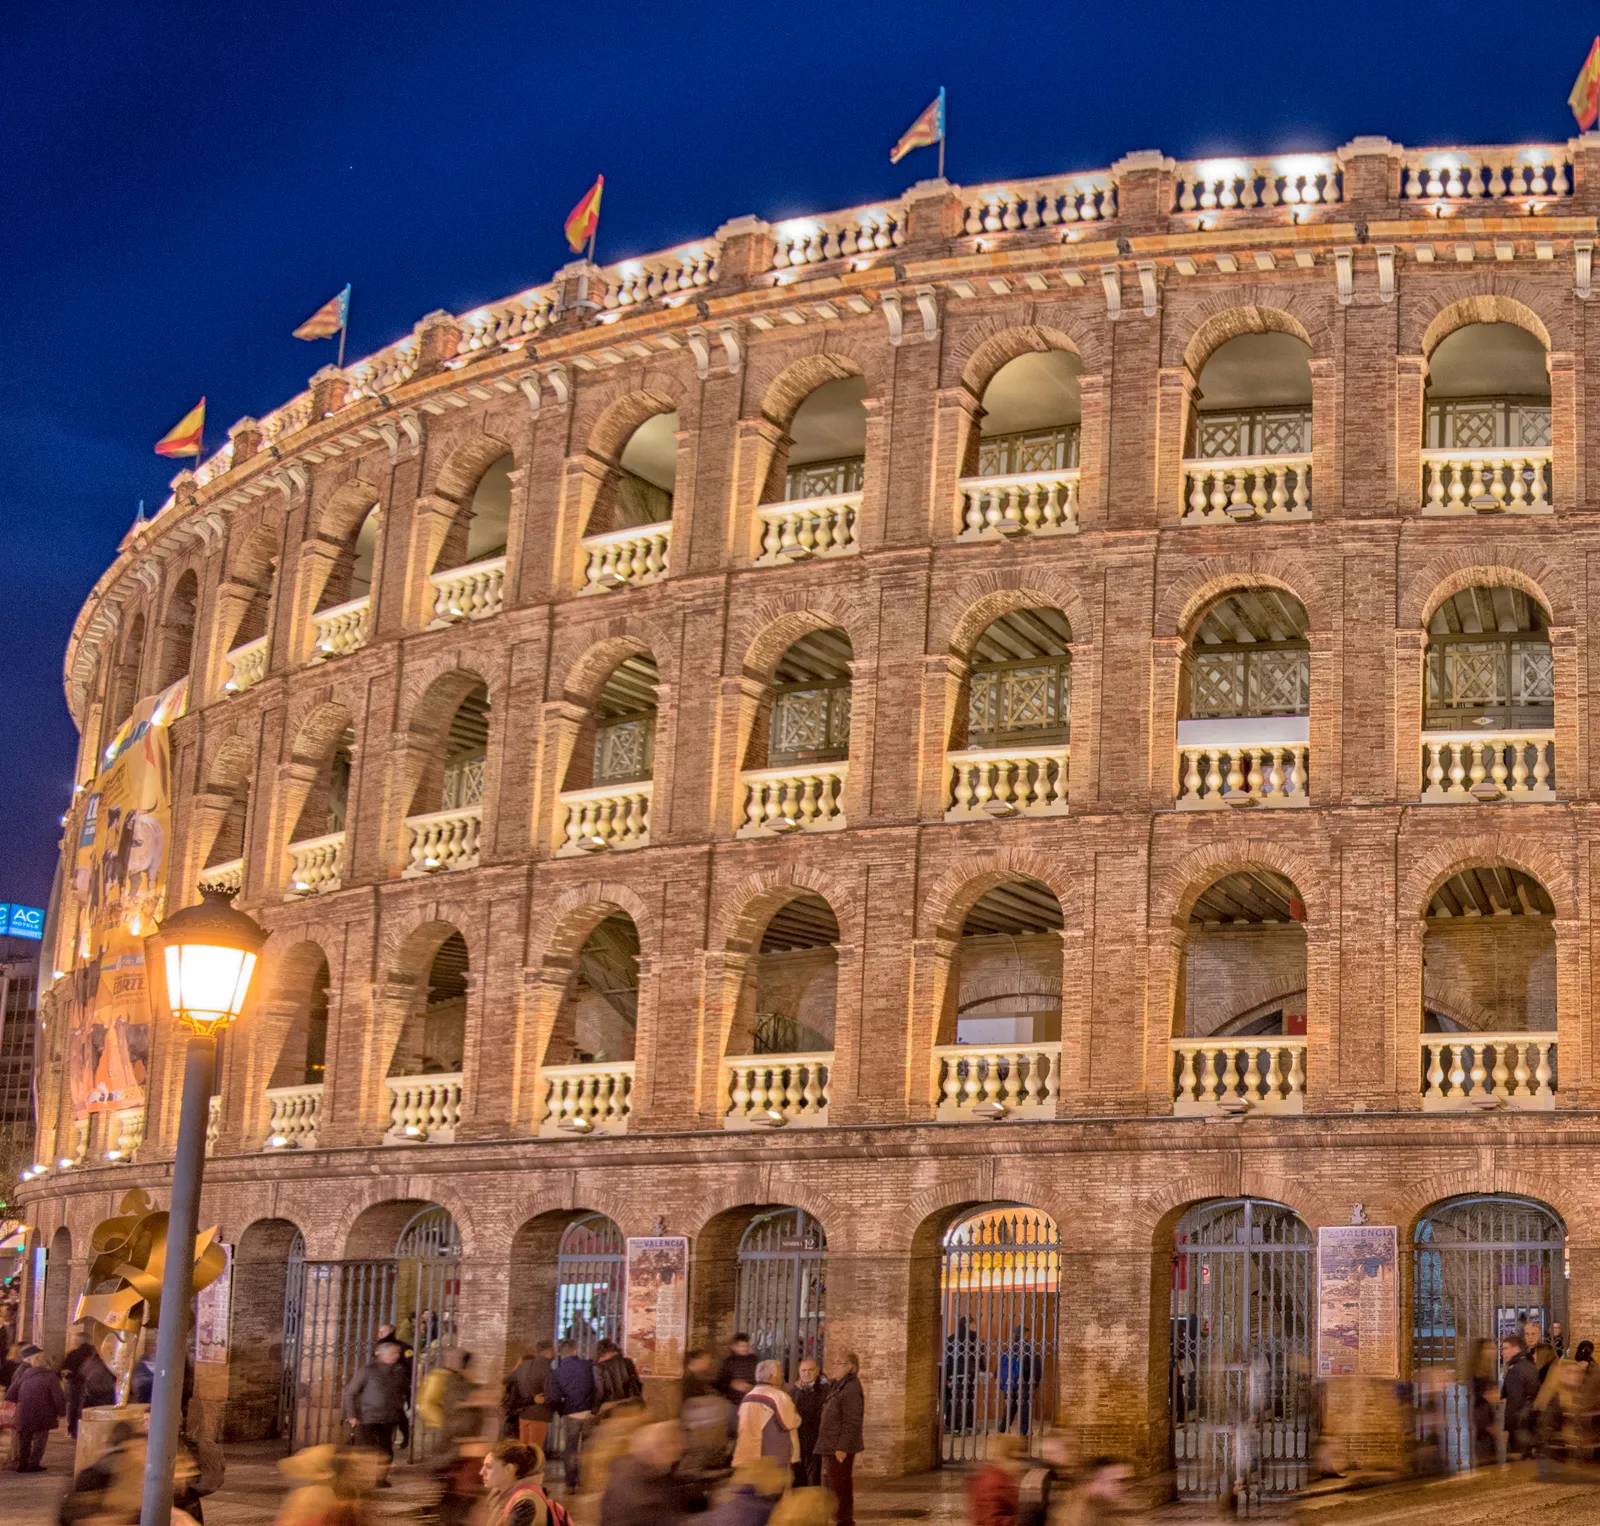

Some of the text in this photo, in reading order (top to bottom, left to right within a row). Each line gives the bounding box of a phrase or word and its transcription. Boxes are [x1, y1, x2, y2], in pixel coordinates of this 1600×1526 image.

[14, 909, 40, 923] AC
[12, 920, 39, 929] HOTELS
[1340, 1229, 1394, 1238] VALENCIA
[644, 1240, 685, 1248] VALENCIA
